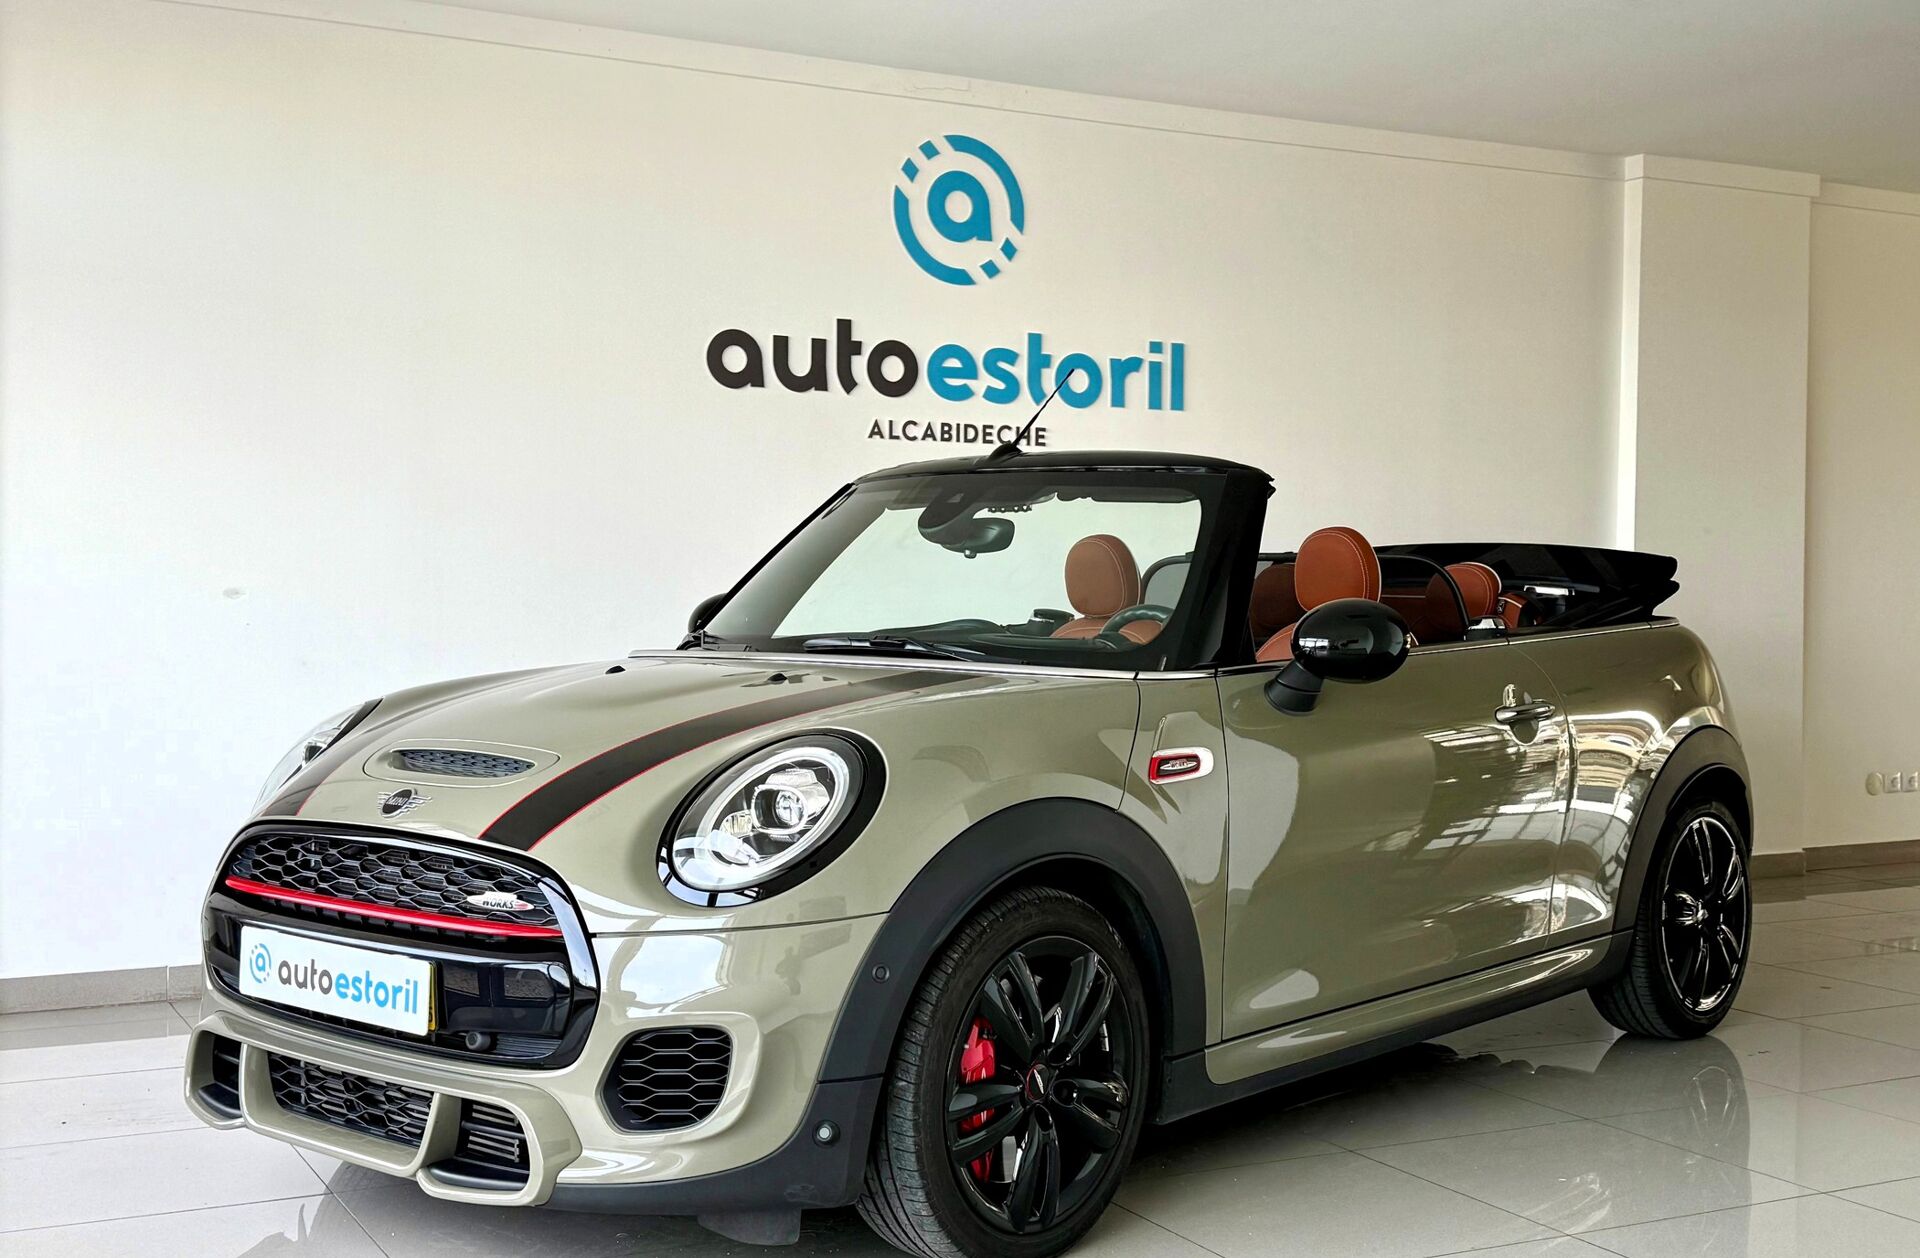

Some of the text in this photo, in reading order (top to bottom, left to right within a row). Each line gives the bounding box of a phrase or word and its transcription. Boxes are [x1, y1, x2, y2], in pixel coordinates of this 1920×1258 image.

[706, 318, 1186, 412] autoestoril
[867, 418, 1047, 447] ALCABIDECHE
[278, 958, 418, 1014] autoestoril
